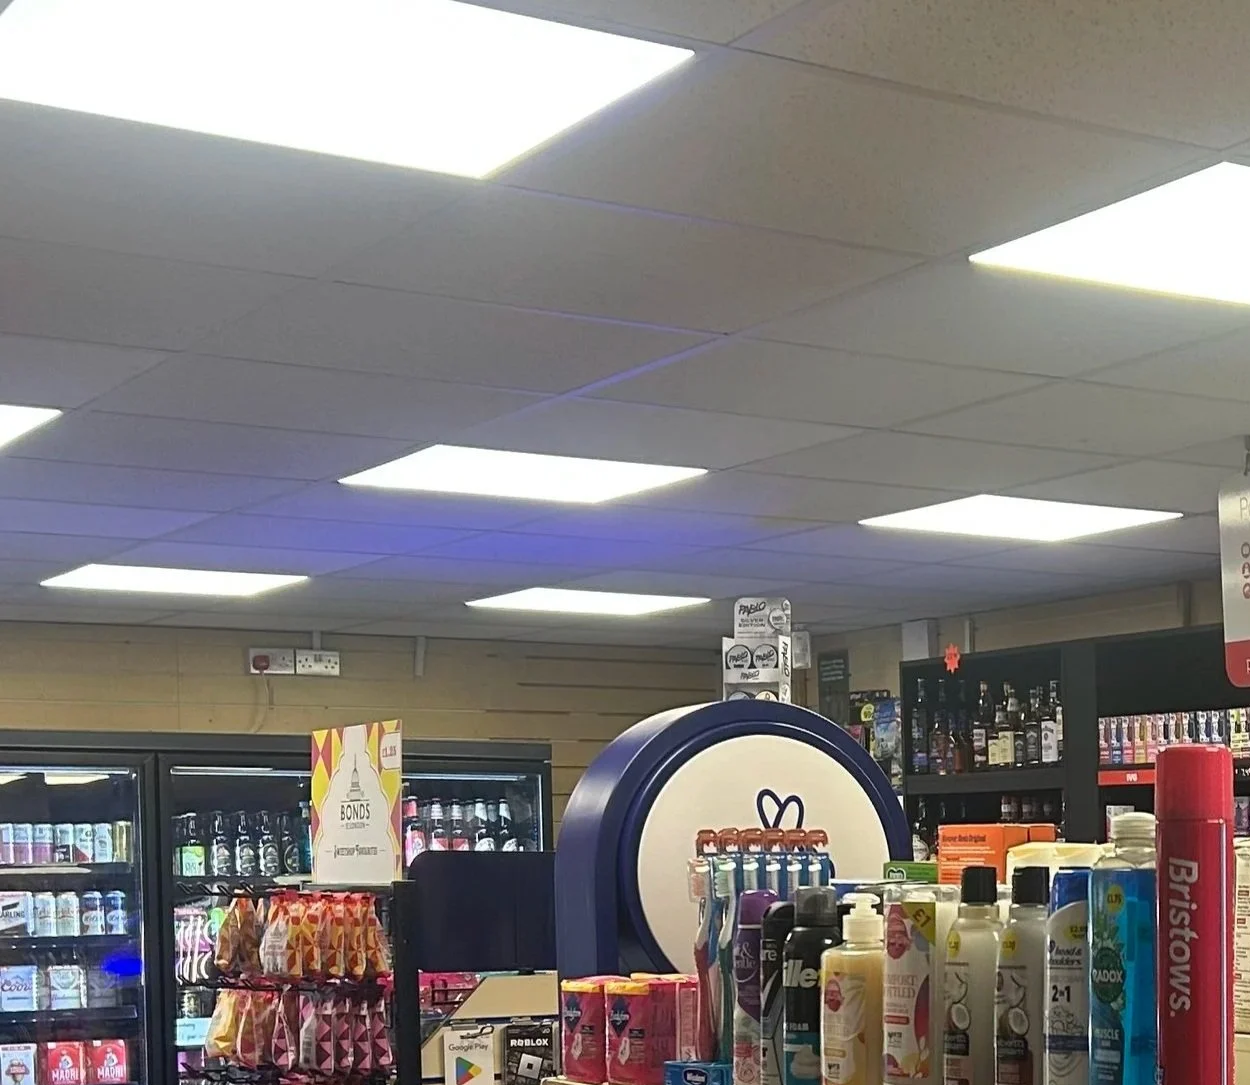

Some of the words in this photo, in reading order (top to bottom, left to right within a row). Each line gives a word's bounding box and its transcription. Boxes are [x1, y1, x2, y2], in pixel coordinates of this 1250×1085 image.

[340, 802, 371, 821] BONDS
[1165, 857, 1200, 1018] Bristows.
[1092, 968, 1123, 984] RADOX
[448, 1042, 473, 1054] Google
[474, 1041, 489, 1053] Play
[510, 1038, 549, 1048] ROBLOX
